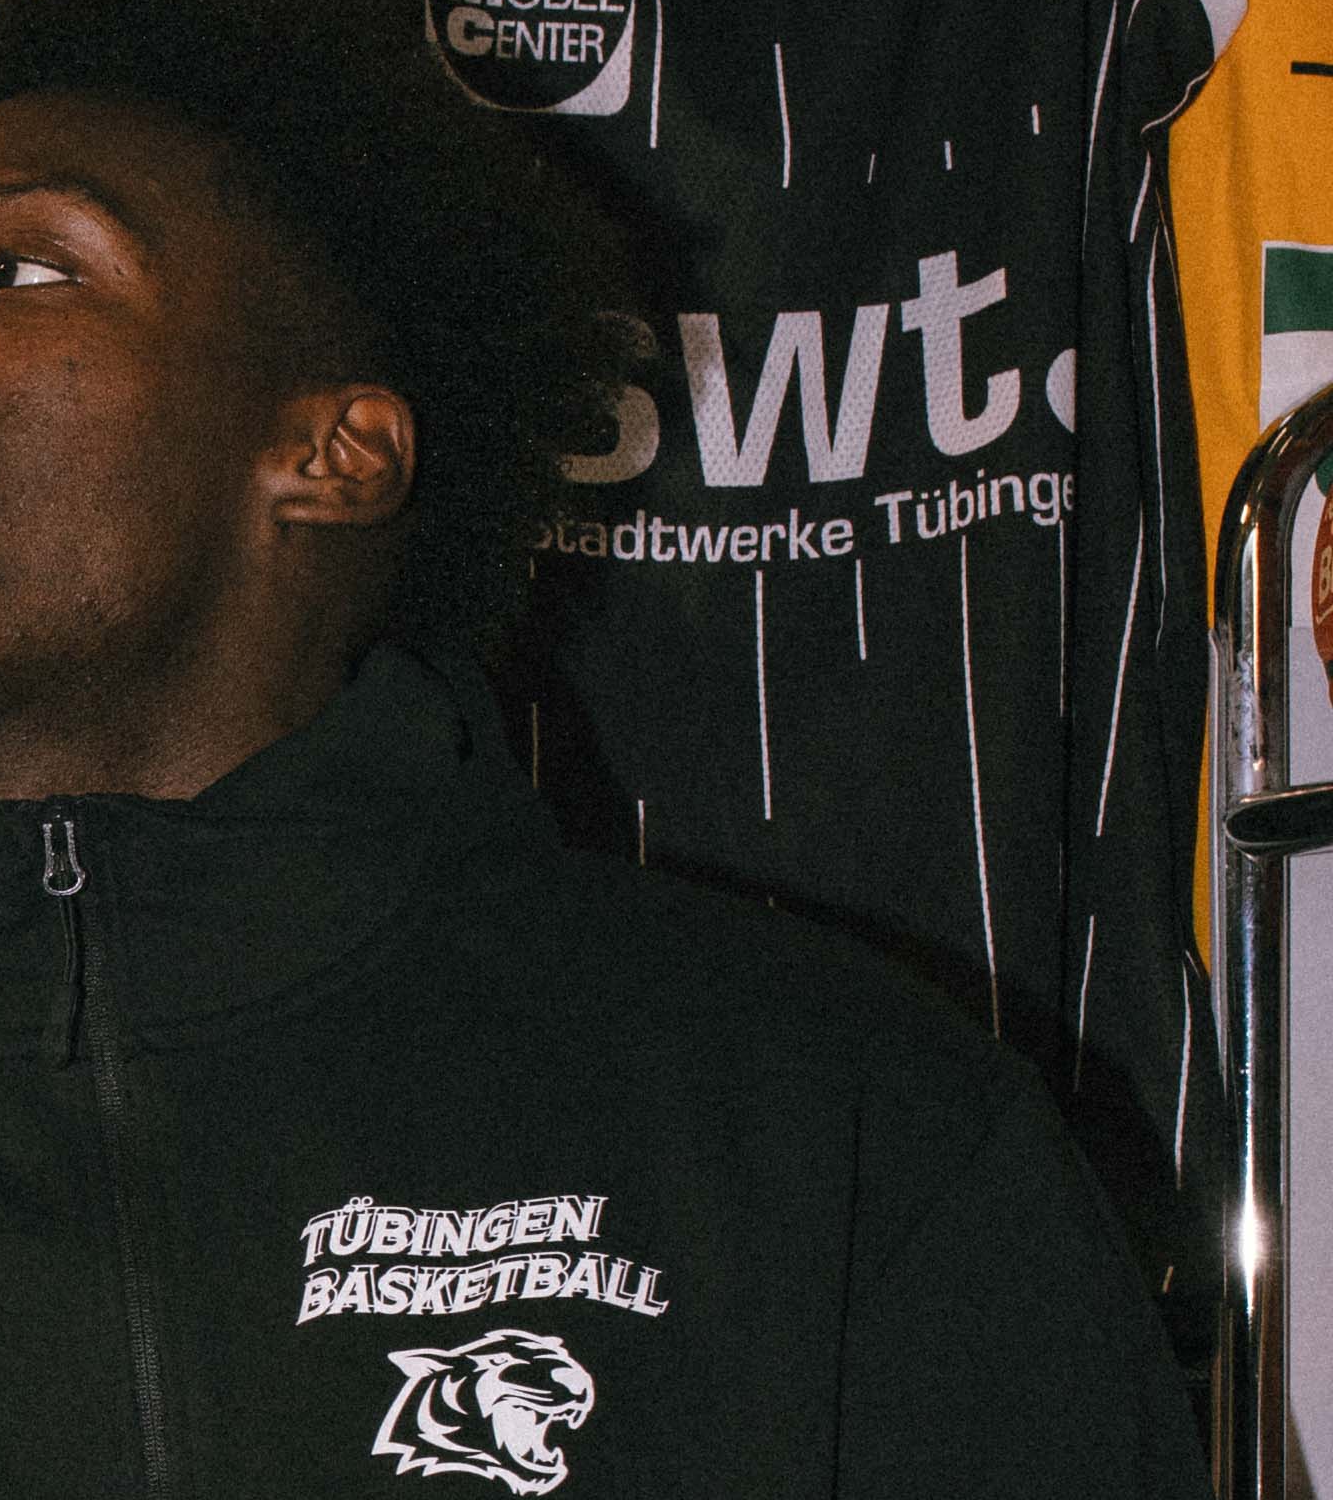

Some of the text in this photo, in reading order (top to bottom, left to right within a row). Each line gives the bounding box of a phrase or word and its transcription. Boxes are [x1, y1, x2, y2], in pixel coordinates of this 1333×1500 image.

[446, 6, 605, 64] CENTER
[300, 1195, 609, 1267] TÜBINGEN
[296, 1252, 670, 1327] BASKETBALL
